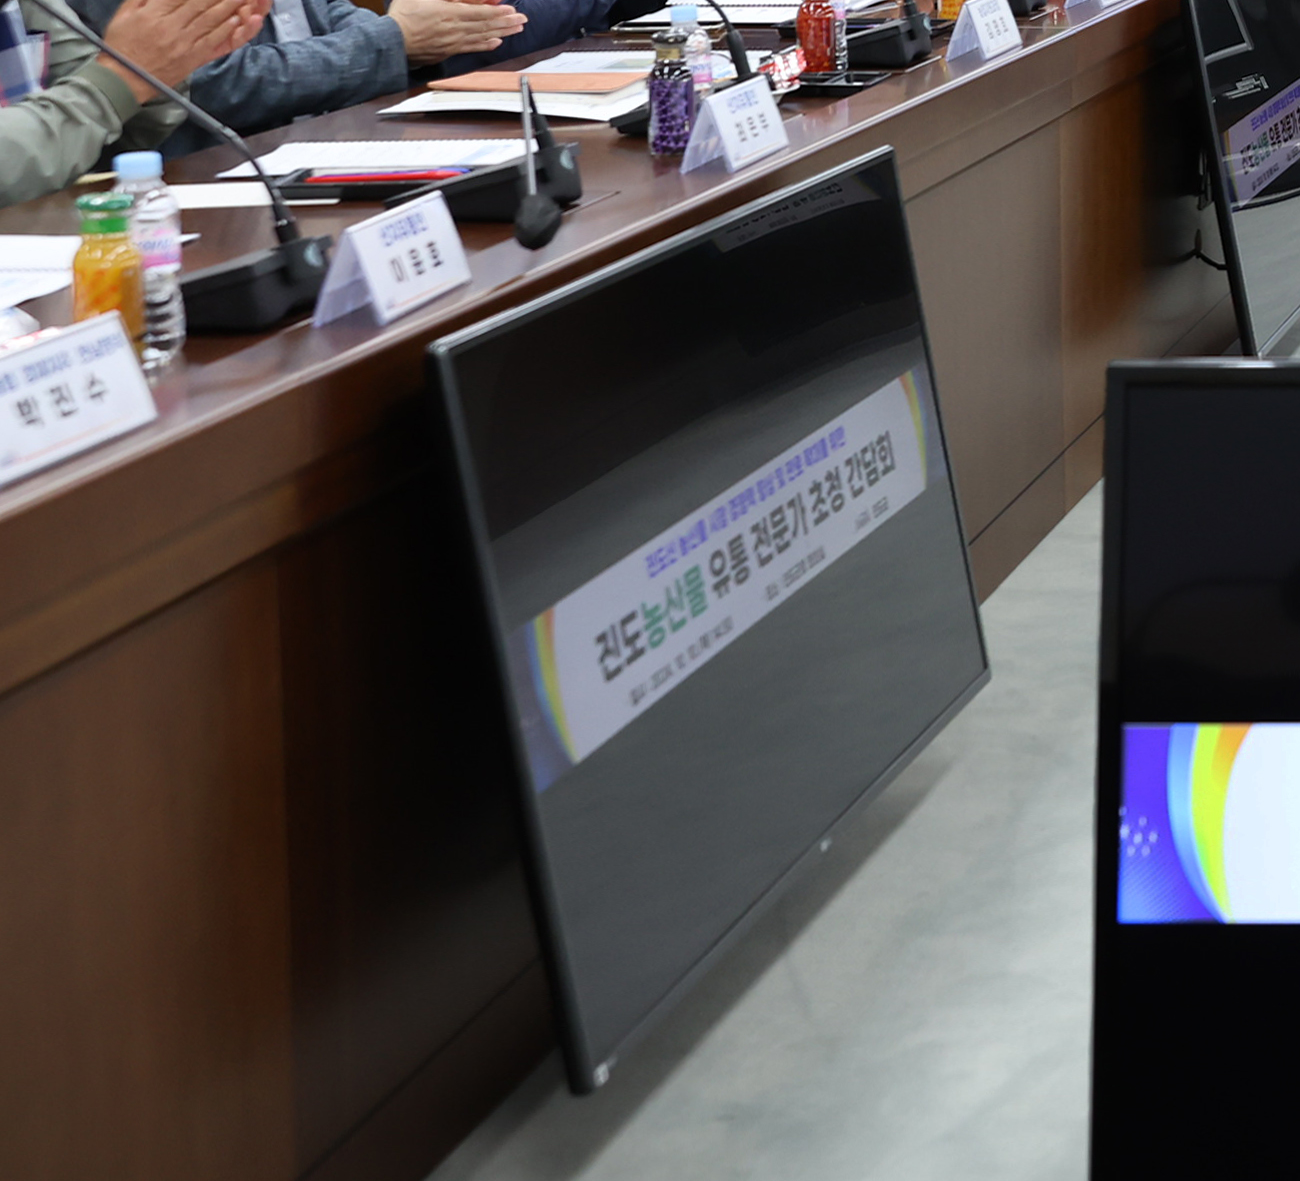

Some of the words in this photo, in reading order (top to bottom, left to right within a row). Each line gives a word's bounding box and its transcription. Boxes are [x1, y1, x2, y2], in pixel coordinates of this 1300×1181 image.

[707, 533, 751, 602] 유통
[751, 493, 808, 569] 전문가
[806, 465, 846, 527] 초청
[844, 431, 896, 499] 간담회
